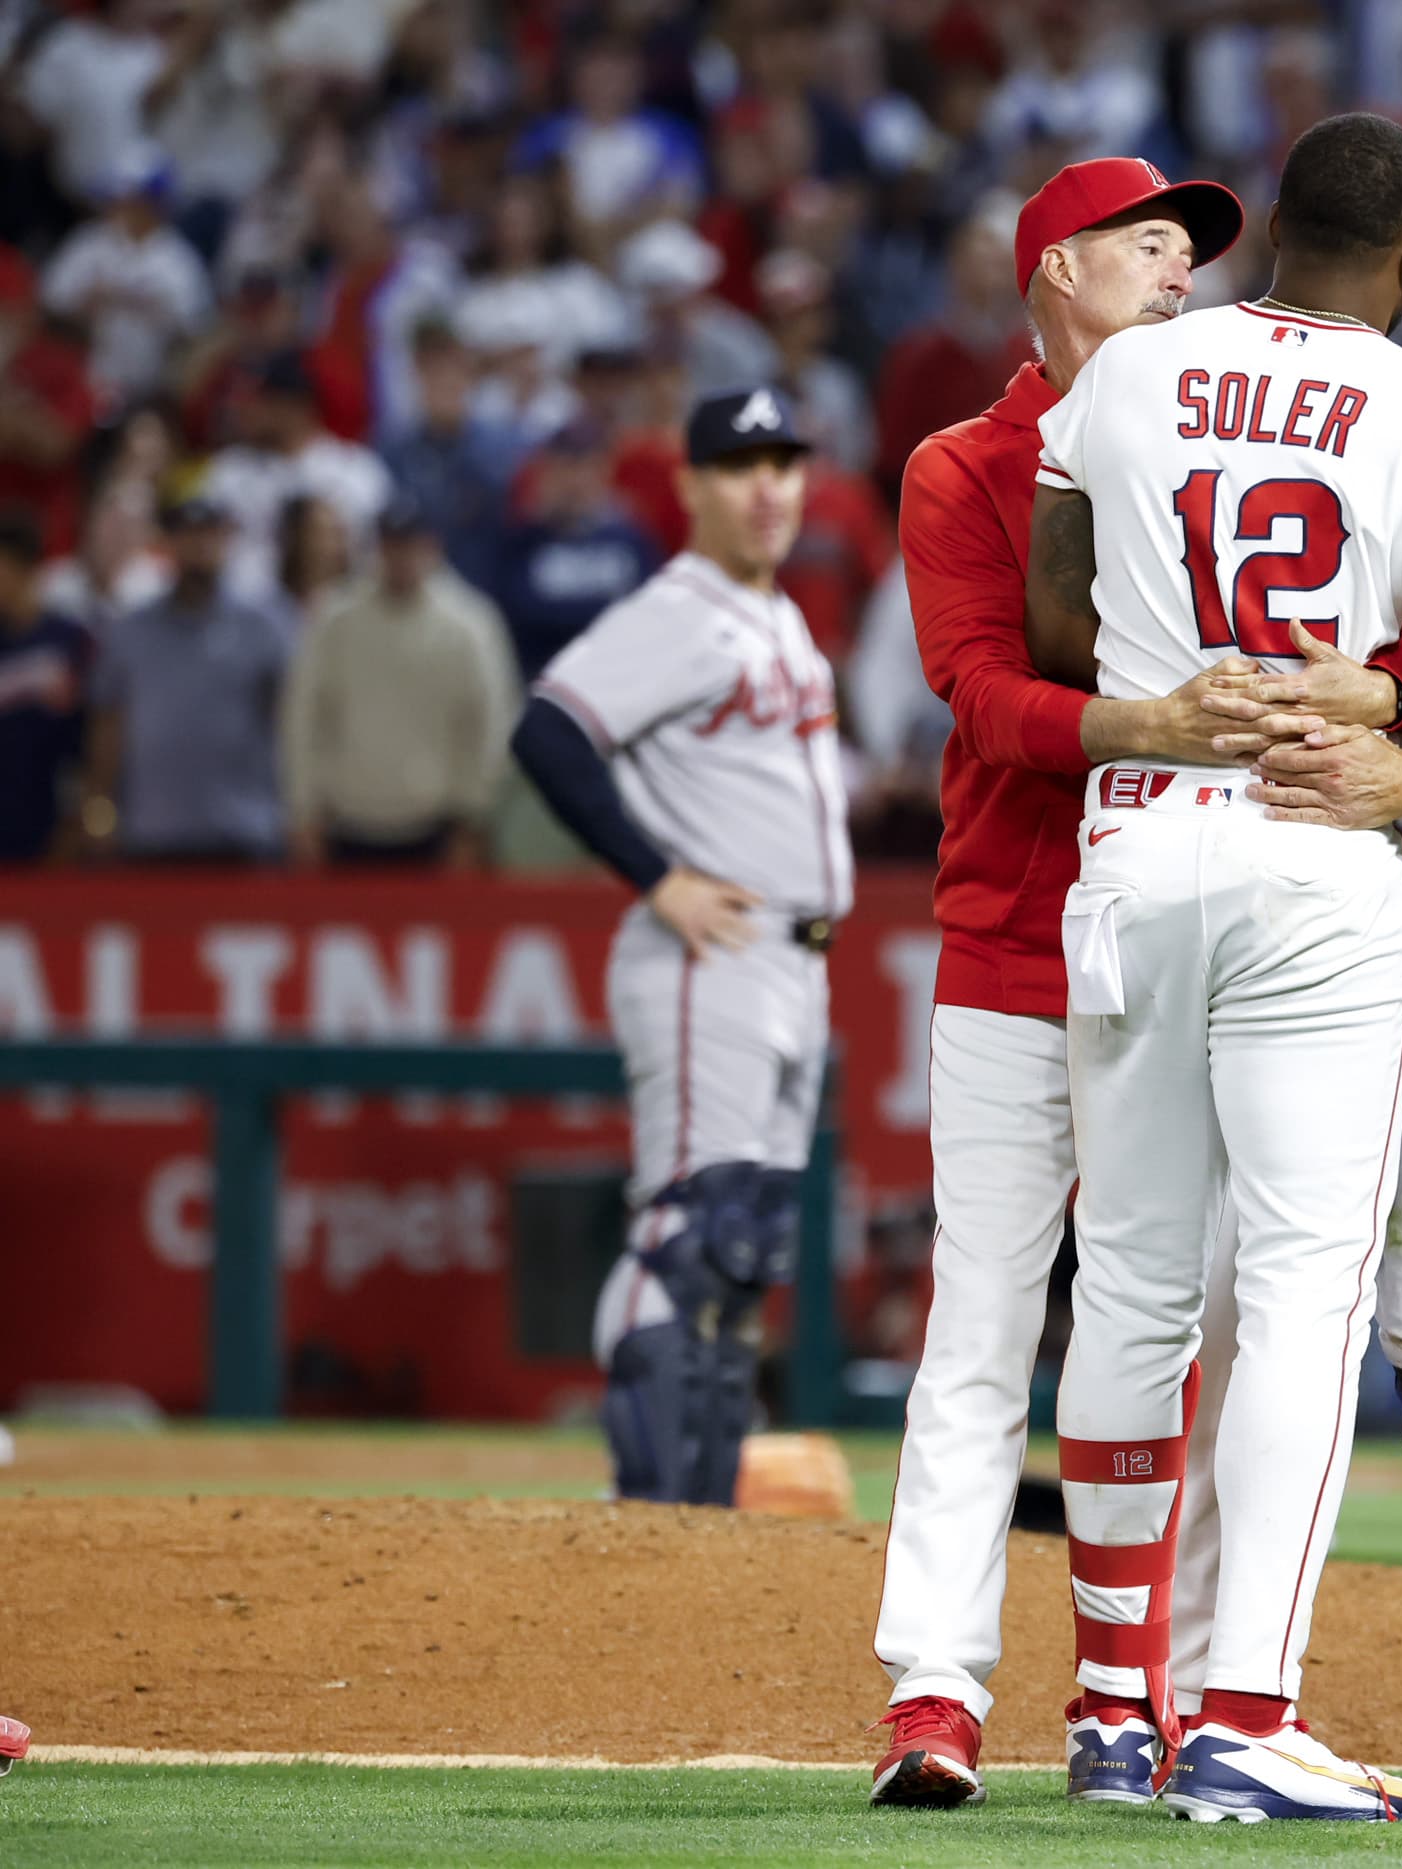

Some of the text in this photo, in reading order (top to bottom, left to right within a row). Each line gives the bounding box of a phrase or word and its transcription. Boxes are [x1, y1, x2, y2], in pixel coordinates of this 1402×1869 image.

[1177, 369, 1368, 458] SOLER
[1173, 469, 1351, 659] 12
[1113, 1450, 1153, 1477] 12
